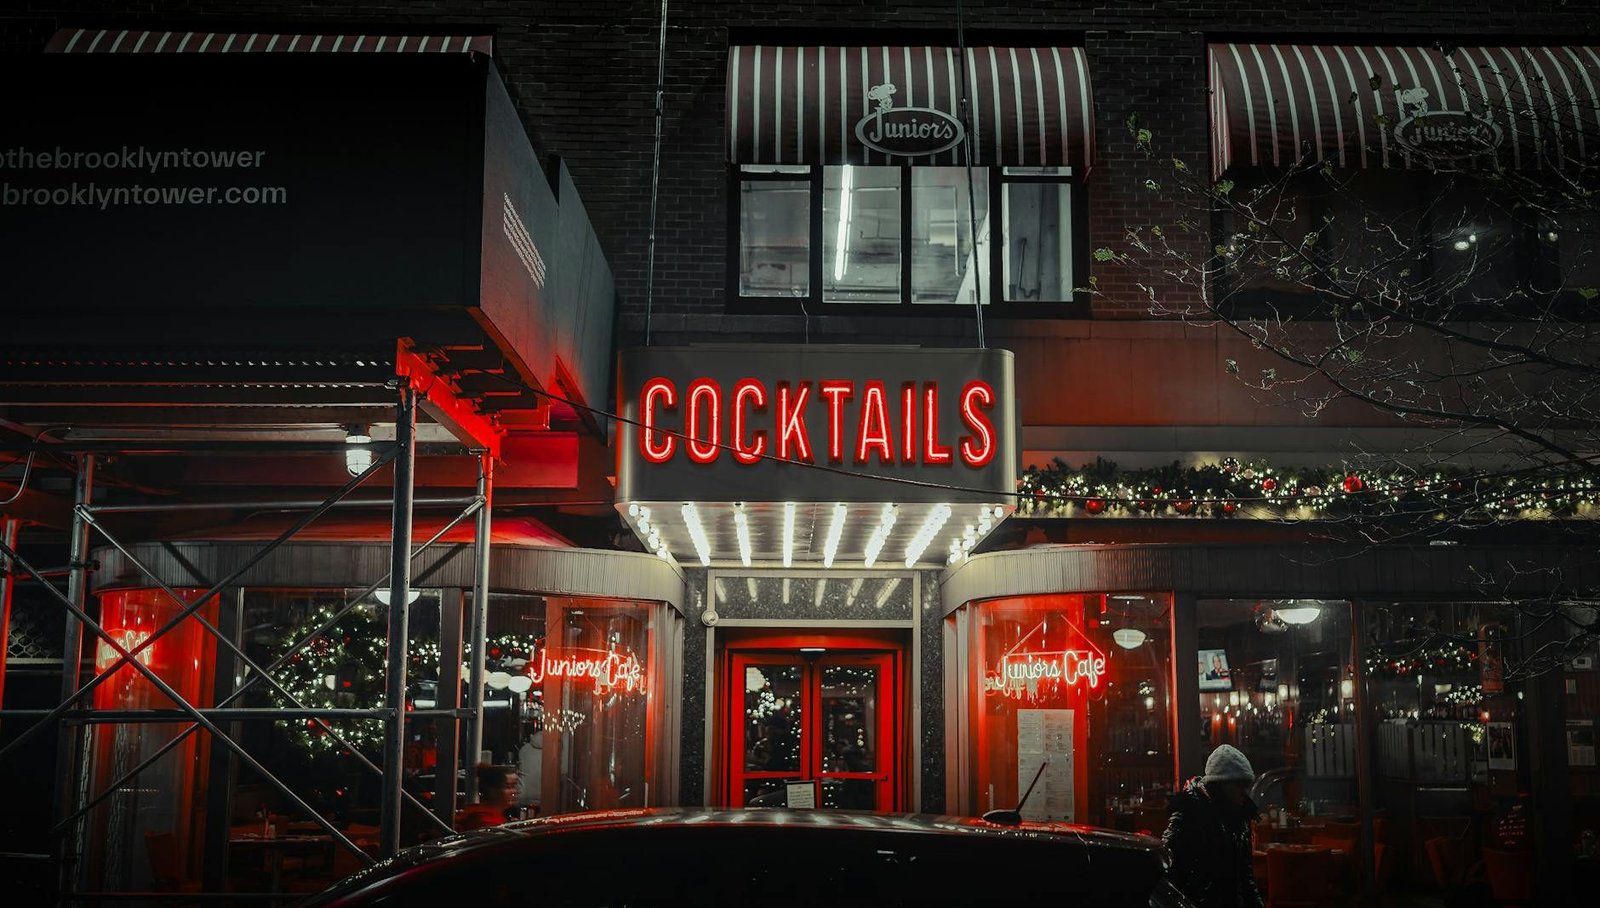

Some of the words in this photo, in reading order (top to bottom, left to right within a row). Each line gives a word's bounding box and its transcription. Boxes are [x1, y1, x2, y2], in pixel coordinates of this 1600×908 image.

[869, 107, 954, 142] Junior's
[0, 146, 266, 174] thebrooklyntower
[3, 182, 287, 210] brooklyntower.com
[639, 376, 996, 467] COCKTAILS
